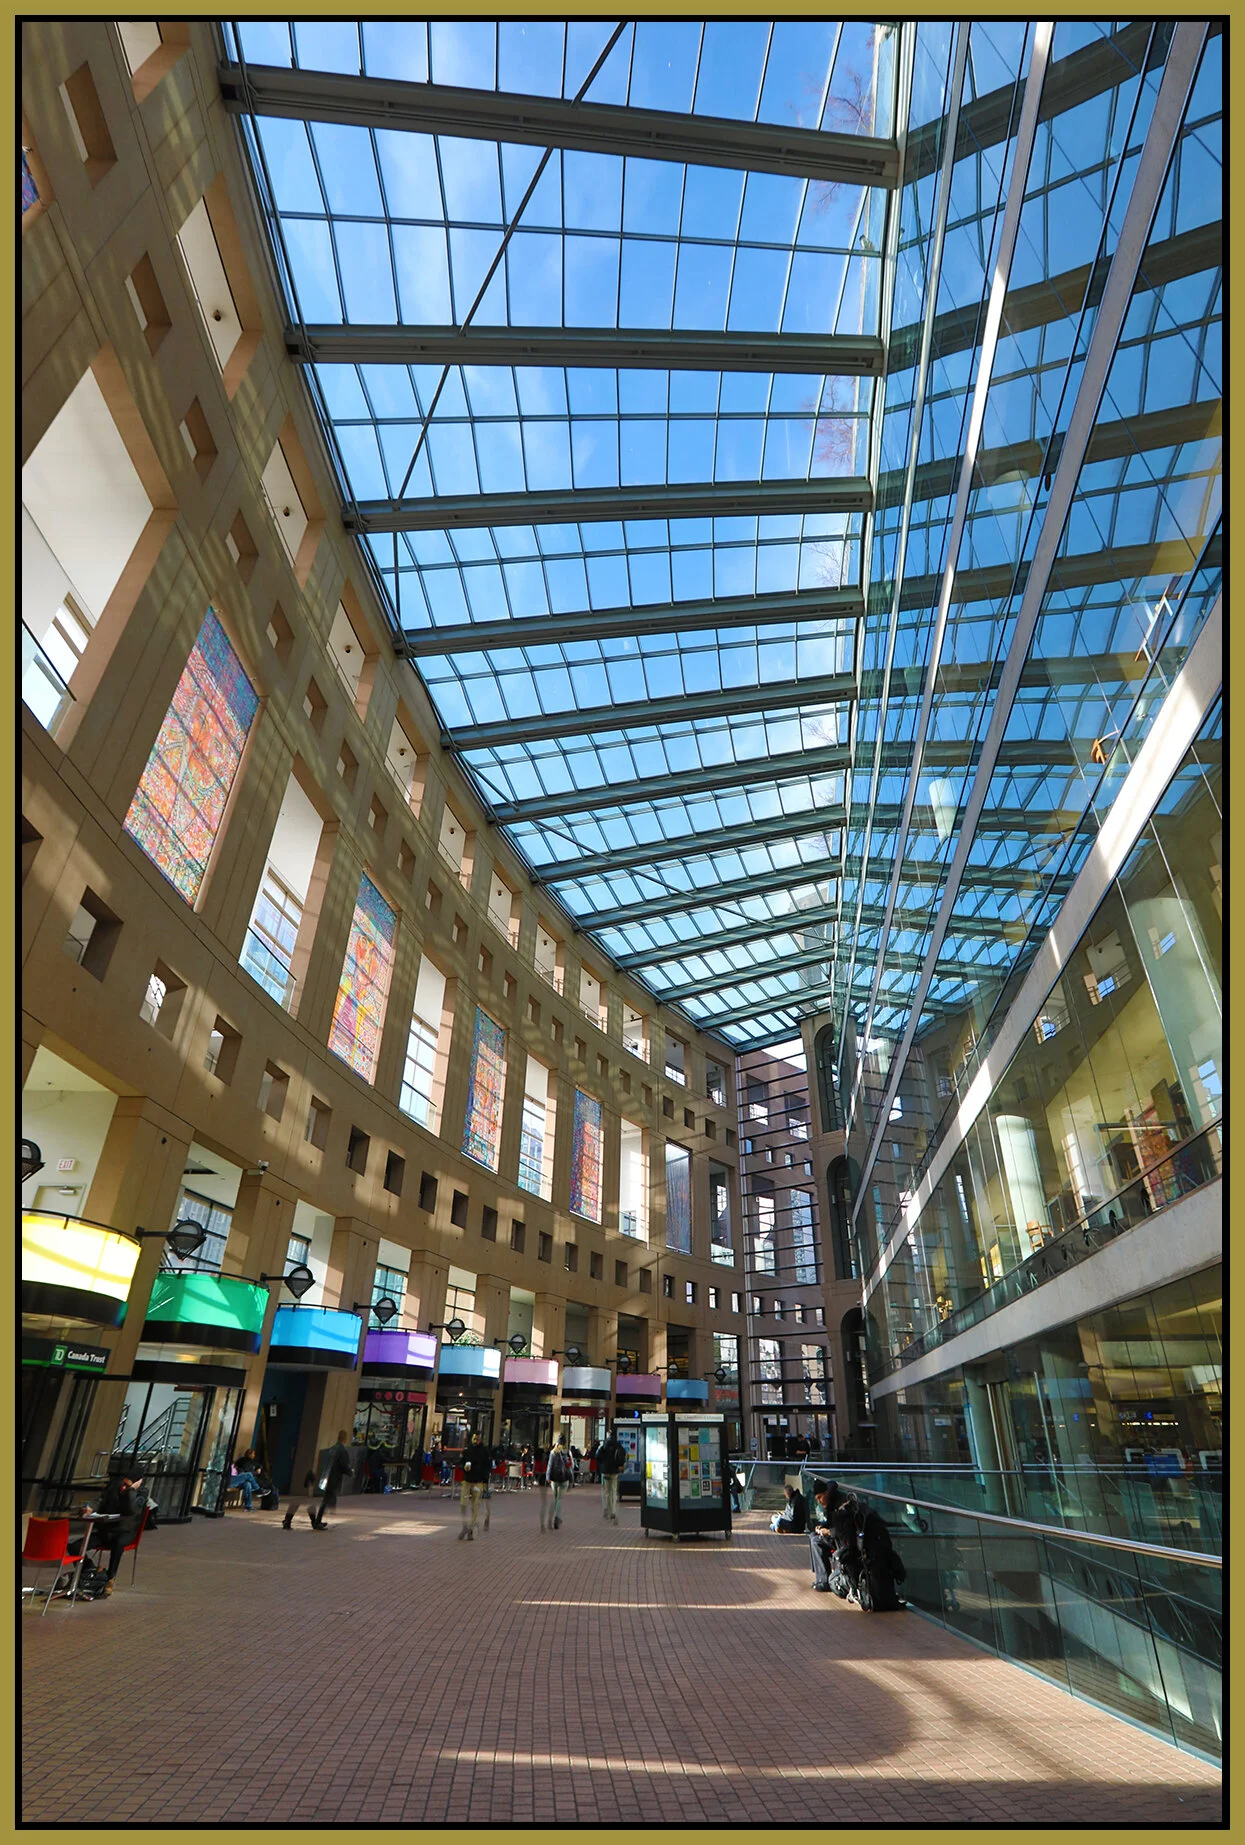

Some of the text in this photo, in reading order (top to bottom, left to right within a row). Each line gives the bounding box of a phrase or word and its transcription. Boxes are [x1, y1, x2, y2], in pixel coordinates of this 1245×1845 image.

[58, 1159, 74, 1169] EXIT
[54, 1348, 106, 1363] TD Canada Trust
